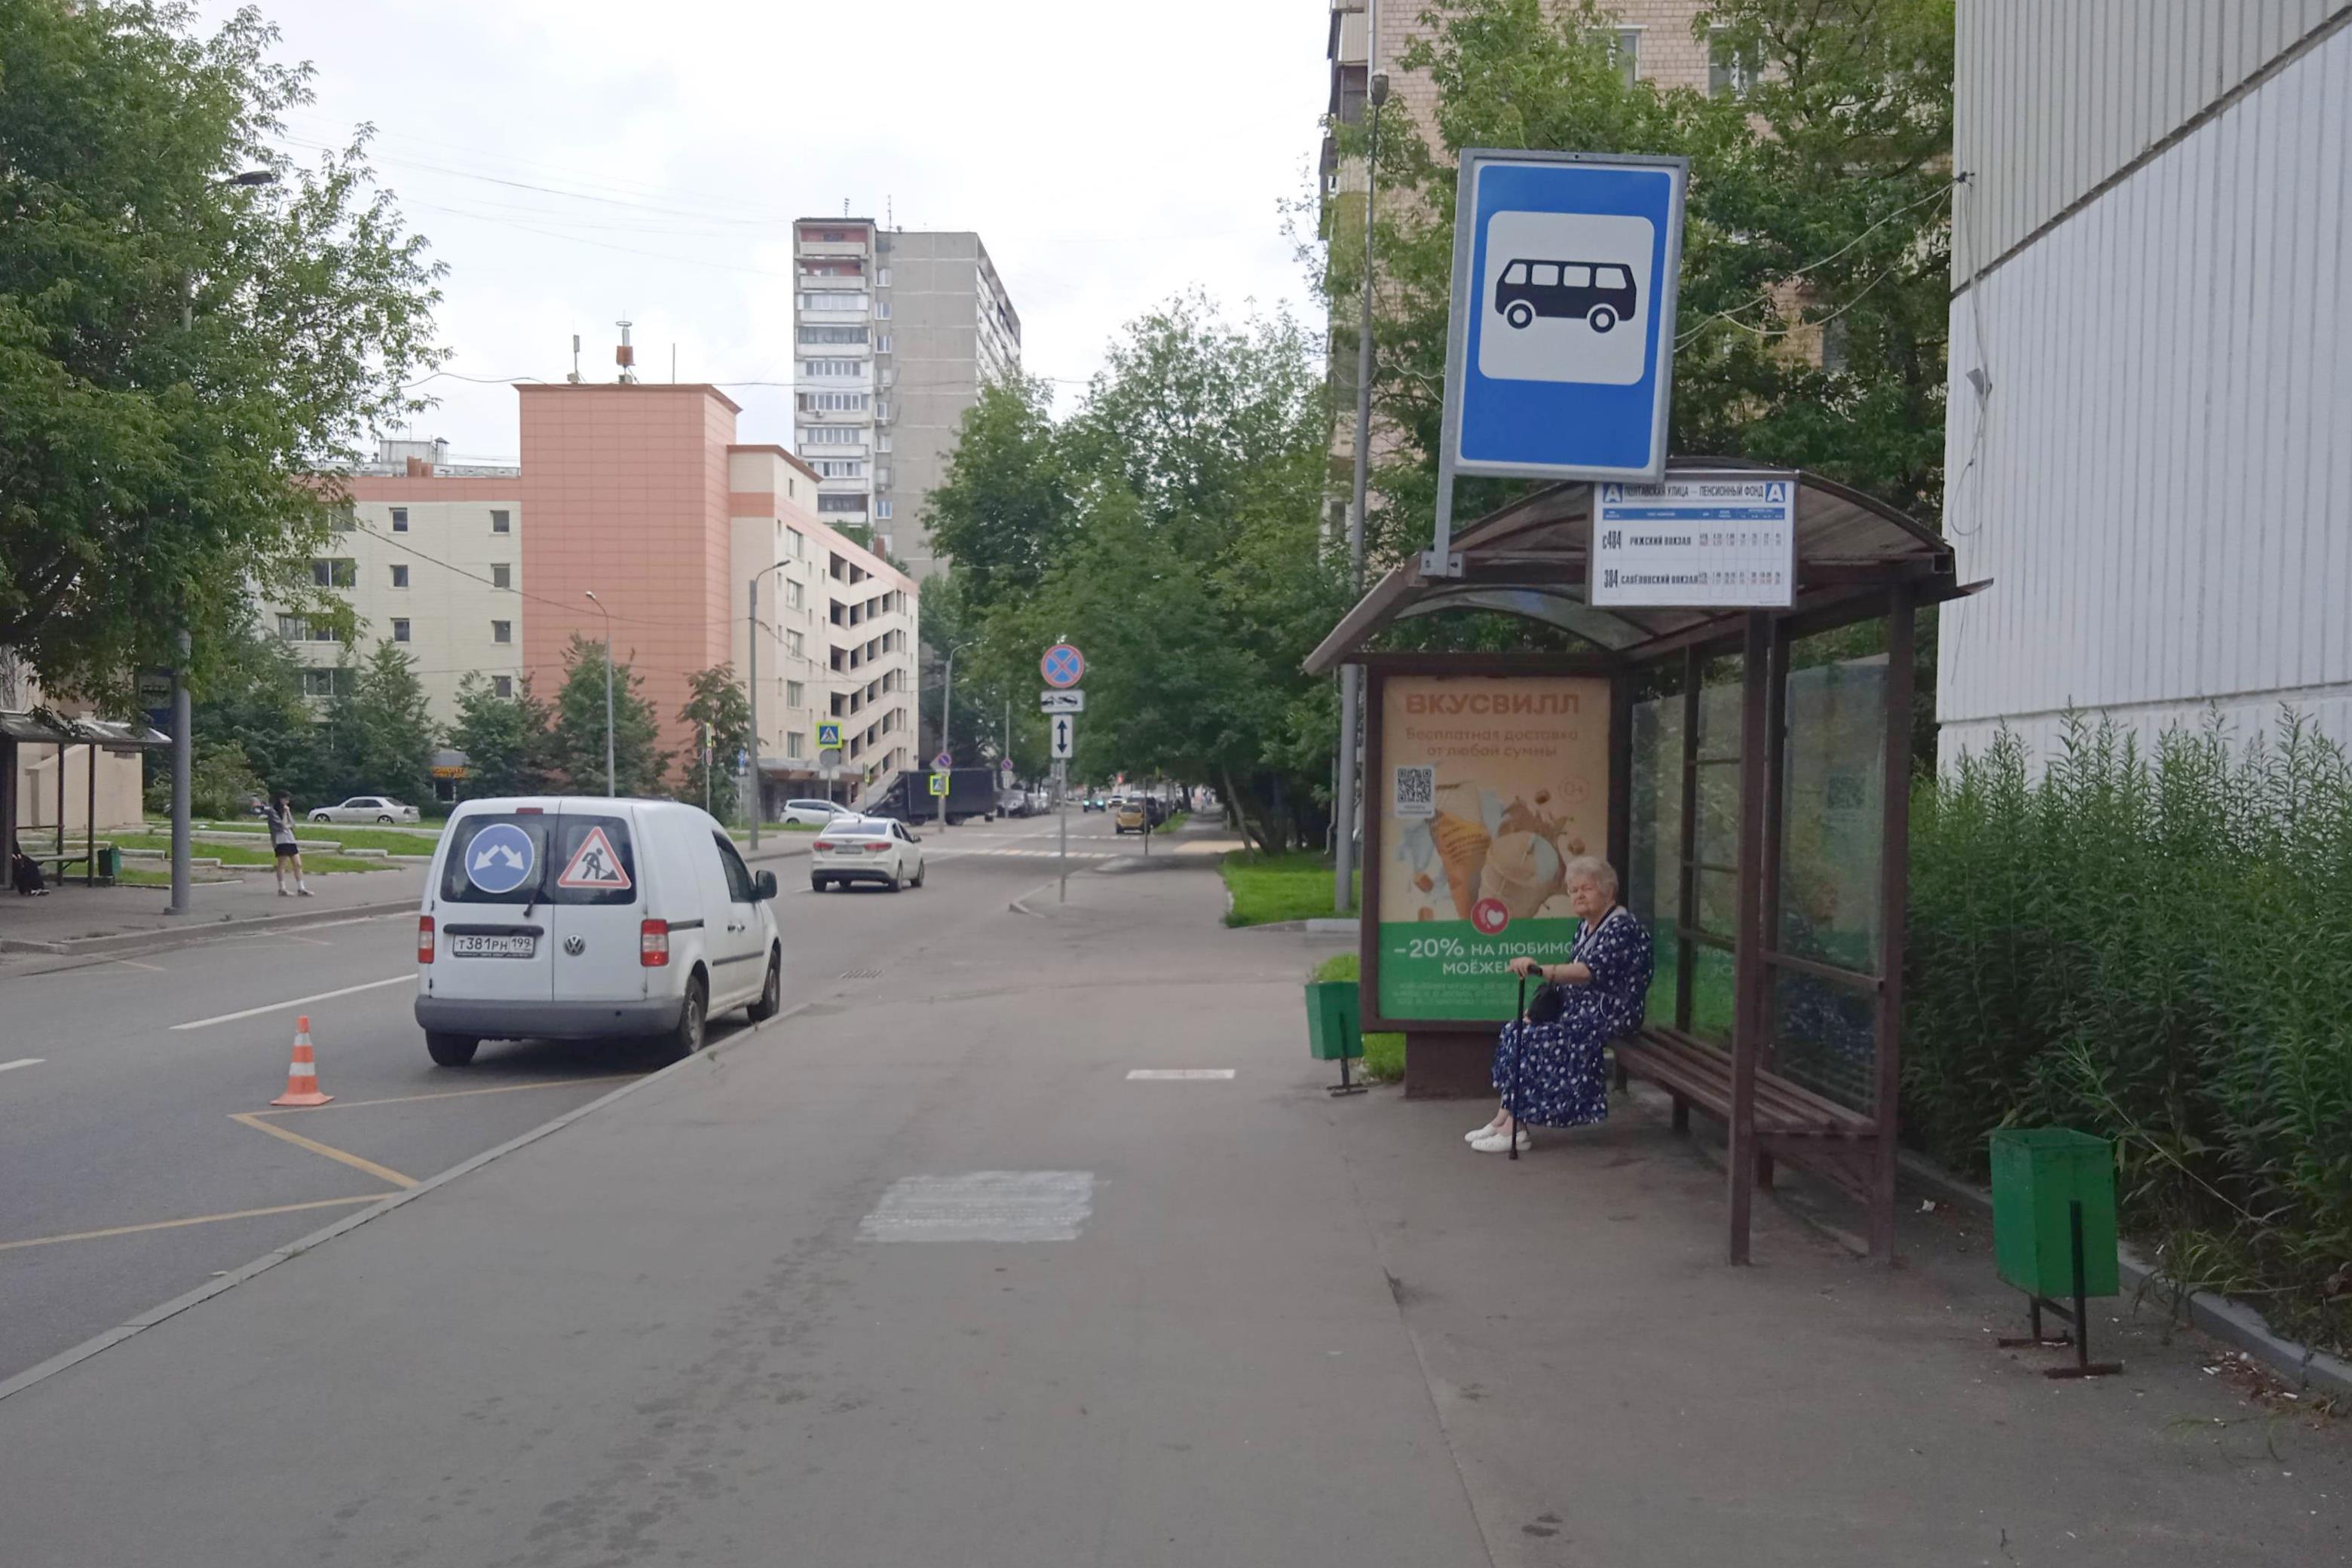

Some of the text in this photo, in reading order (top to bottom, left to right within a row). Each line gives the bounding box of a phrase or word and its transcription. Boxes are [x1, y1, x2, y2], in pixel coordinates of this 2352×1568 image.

[1668, 485, 1689, 498] УЛИЦА
[1699, 482, 1743, 497] ПЕНСИОННЫЙ
[1744, 485, 1763, 498] ФОНД
[1630, 535, 1662, 546] РИЖСКИЙ
[1664, 536, 1691, 546] ВОКЗАЛ
[1603, 569, 1618, 588] 384
[1621, 574, 1670, 584] САВЁЛОВСКИЙ
[1671, 574, 1698, 584] ВОКЗАЛ
[1406, 694, 1579, 715] ВКУСВИЛЛ
[1405, 727, 1579, 742] Бесплатная доставка
[1427, 744, 1557, 759] от любой суммы
[1471, 944, 1495, 955] НА
